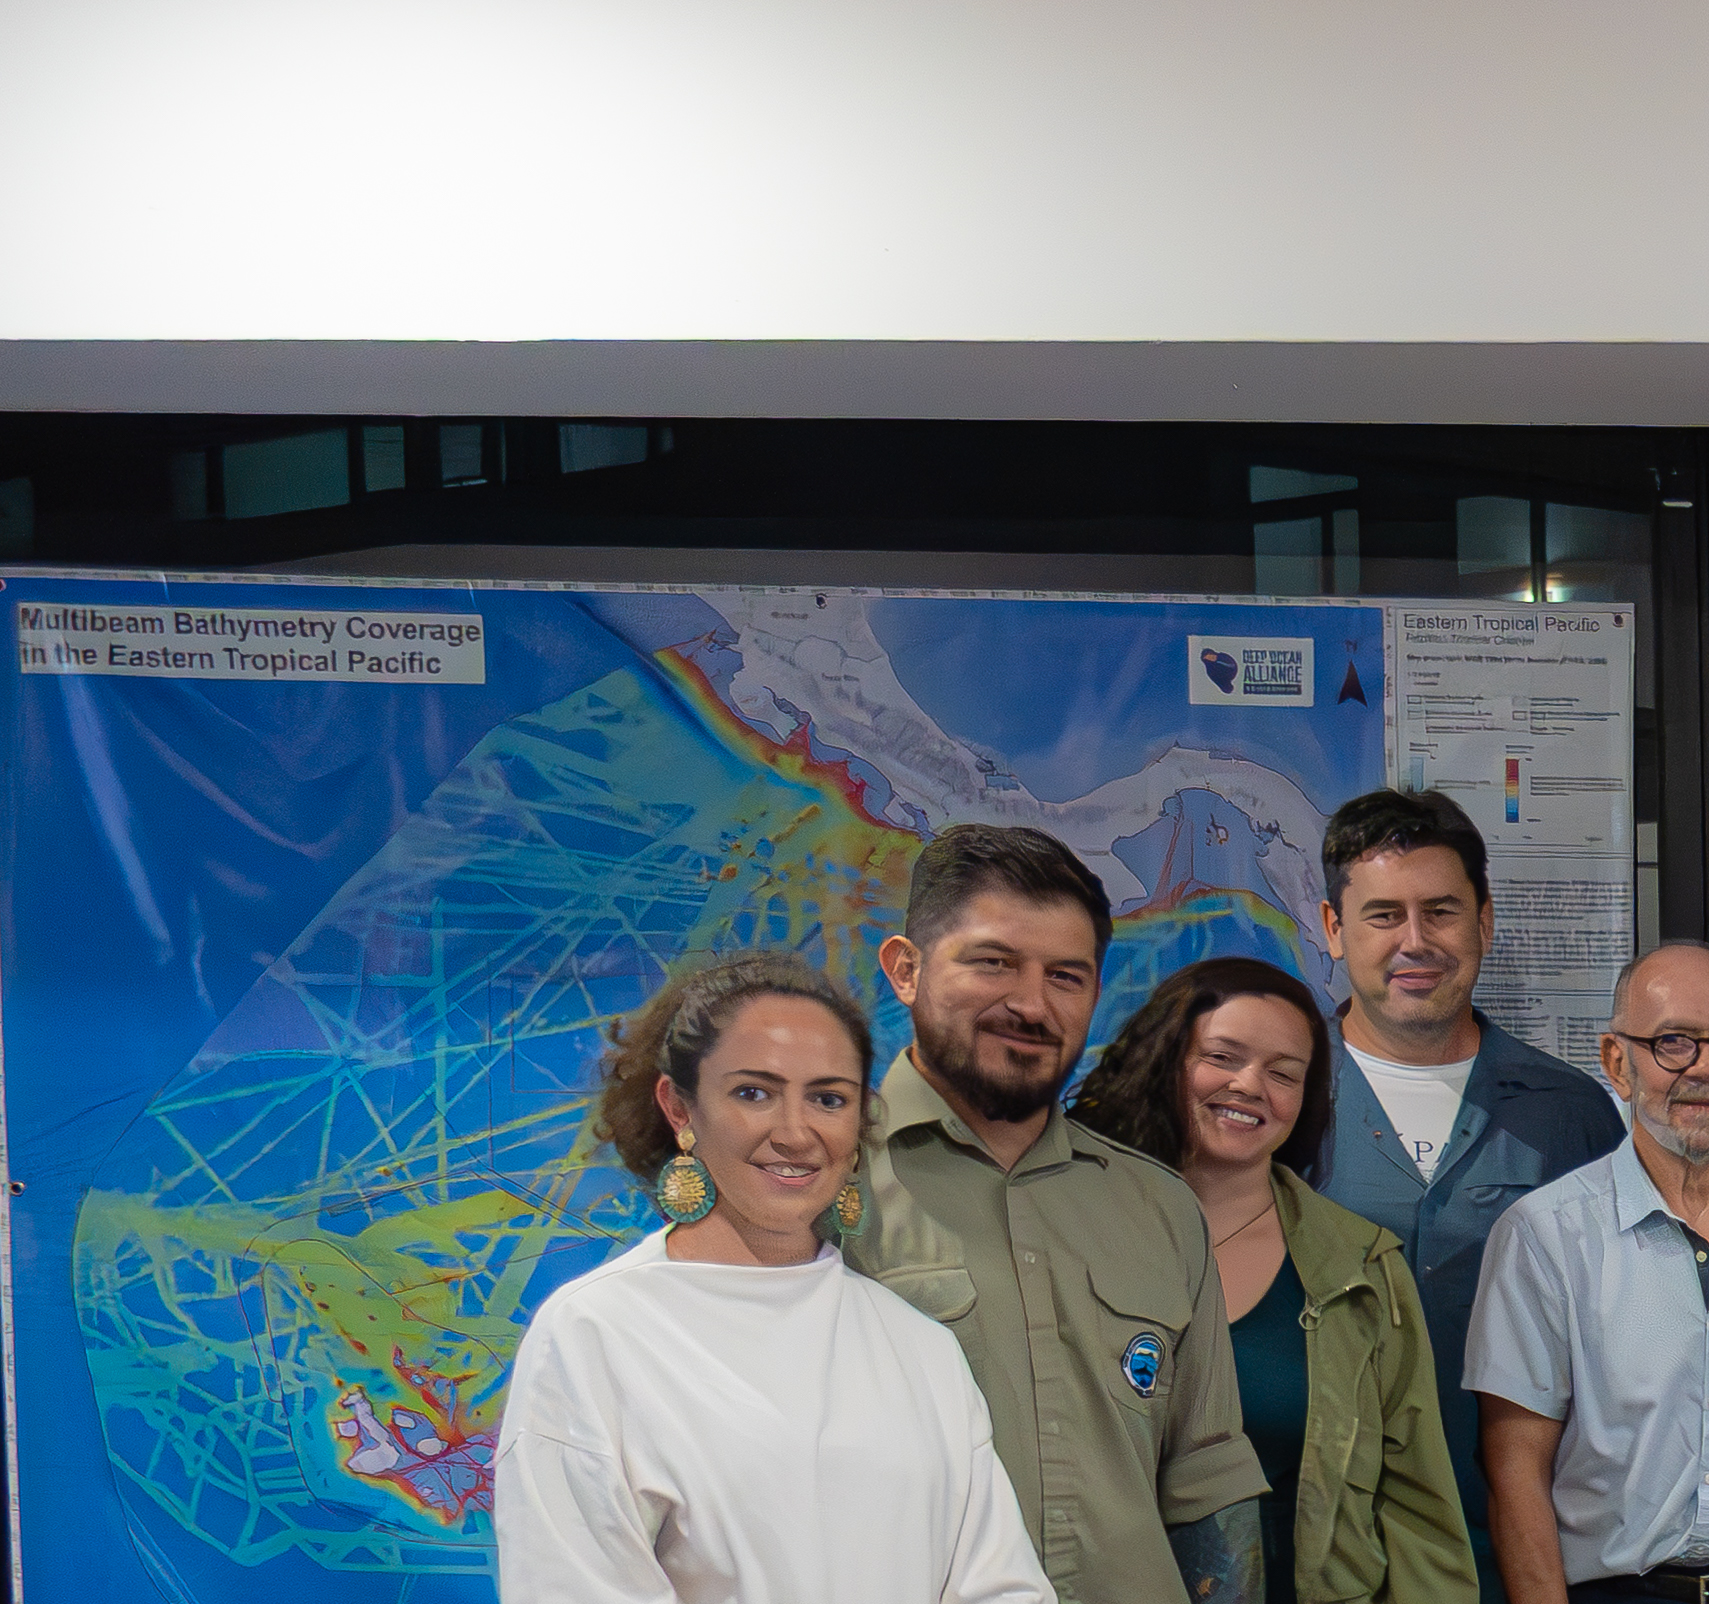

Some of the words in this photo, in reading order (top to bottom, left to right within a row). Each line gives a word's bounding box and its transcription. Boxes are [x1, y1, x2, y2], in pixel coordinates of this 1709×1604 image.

[20, 607, 165, 635] Multibeam
[174, 612, 338, 641] Bathymetry
[346, 616, 483, 647] Coverage
[1403, 613, 1468, 630] Eastern
[1472, 615, 1539, 633] Tropical
[1545, 616, 1600, 632] Pacific
[20, 640, 47, 667] in
[54, 643, 98, 668] the
[108, 644, 215, 670] Eastern
[223, 648, 338, 678] Tropical
[348, 650, 442, 675] Pacific
[1243, 665, 1303, 684] ALLIANCE
